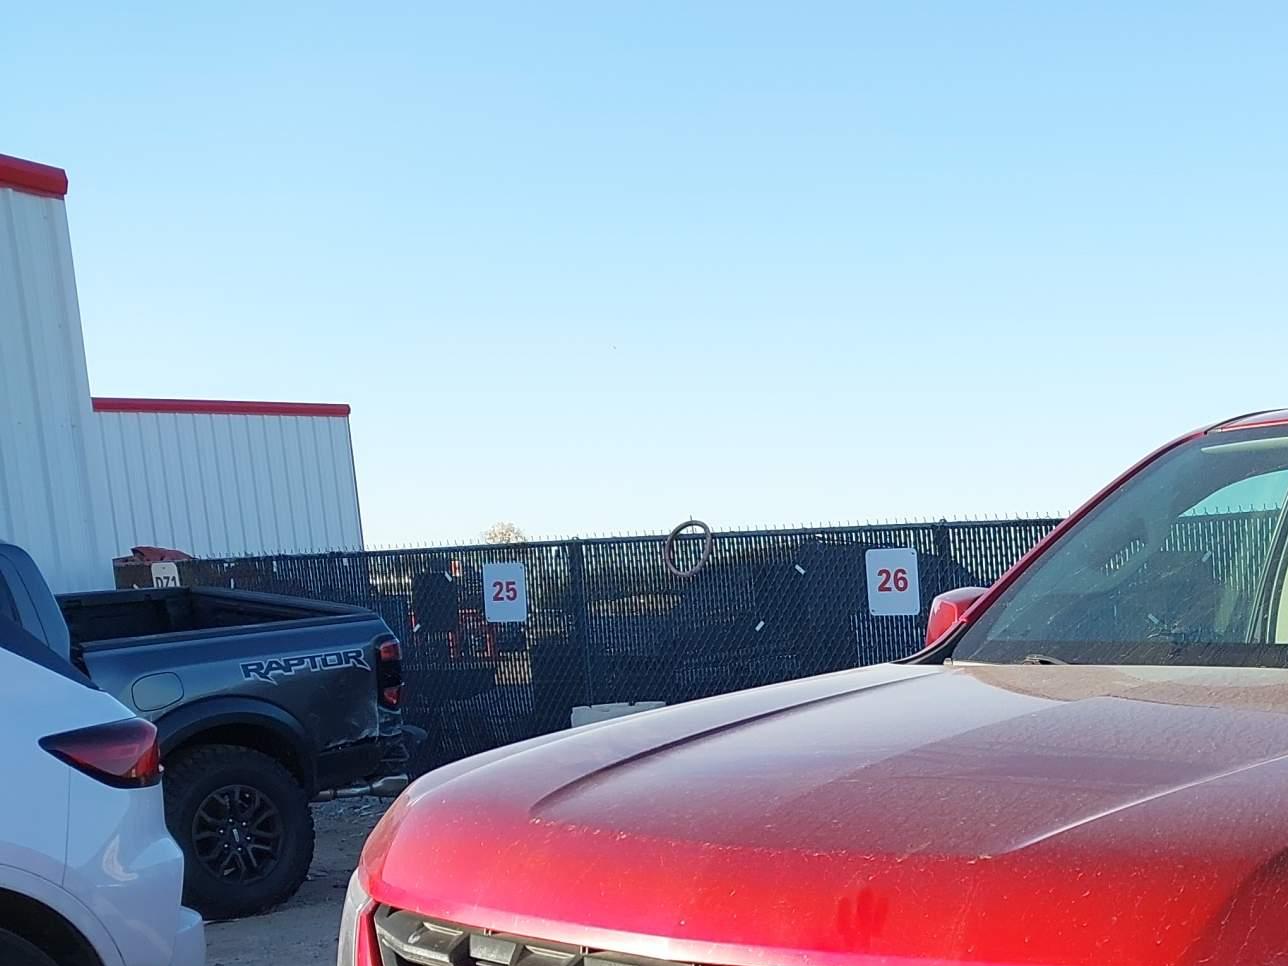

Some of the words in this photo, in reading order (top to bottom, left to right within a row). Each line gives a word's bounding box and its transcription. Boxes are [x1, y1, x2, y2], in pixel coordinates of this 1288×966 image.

[492, 581, 517, 601] 25
[877, 568, 909, 592] 26
[240, 648, 371, 685] RAPTOR
